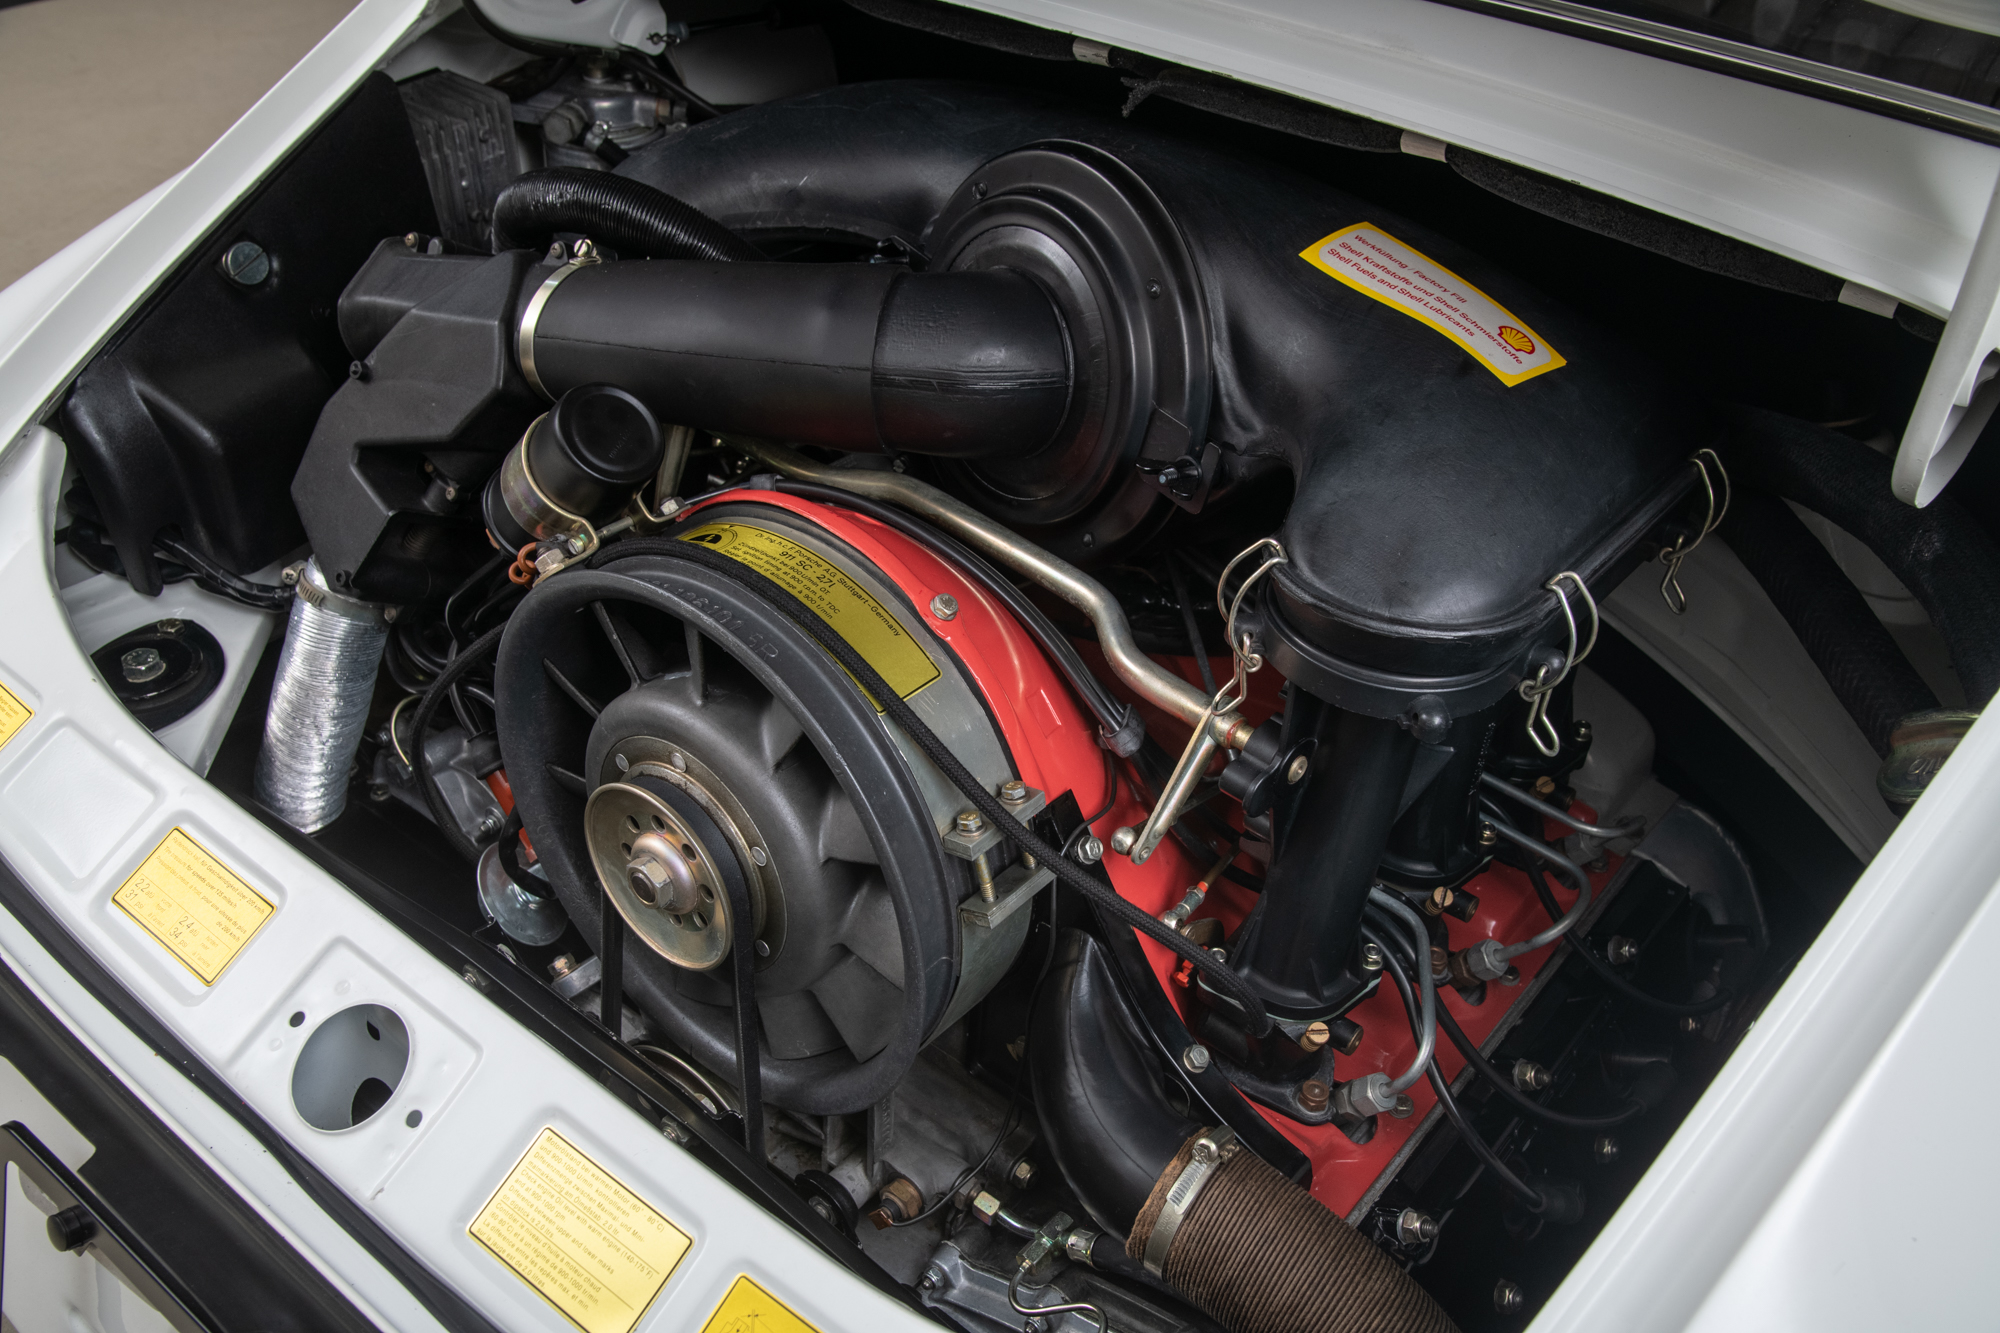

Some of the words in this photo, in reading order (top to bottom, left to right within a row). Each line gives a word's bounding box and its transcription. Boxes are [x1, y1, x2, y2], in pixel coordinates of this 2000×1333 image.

[1354, 234, 1408, 269] Werkfüllung
[1413, 270, 1450, 293] Factory
[1450, 289, 1468, 304] Fill
[1327, 248, 1351, 264] Shell
[1351, 262, 1378, 280] Fuels
[1377, 278, 1398, 290] and
[1397, 287, 1424, 304] Shell
[1423, 301, 1476, 337] Lubricants
[1338, 241, 1363, 258] Shell
[1363, 255, 1413, 287] Kraftstoffe
[1413, 284, 1435, 298] und
[1434, 294, 1459, 314] Shell
[1459, 312, 1523, 366] Schmierstoffe
[779, 550, 796, 561] 911
[796, 560, 813, 571] SC
[794, 547, 823, 568] Porsche
[764, 560, 782, 572] timing
[790, 574, 803, 585] 900
[826, 602, 841, 615] TDC
[803, 594, 817, 605] 900
[124, 888, 138, 901] 31
[133, 877, 151, 894] 2,2
[185, 864, 193, 872] for
[191, 869, 207, 884] speeds
[205, 881, 216, 891] over
[168, 926, 182, 940] 34
[177, 914, 194, 932] 2,4
[539, 1144, 551, 1155] und
[550, 1152, 577, 1175] 900-1000
[594, 1187, 630, 1218] kontrollieren
[545, 1135, 582, 1166] Motorölstand
[580, 1163, 591, 1173] bei
[590, 1172, 612, 1191] warmen
[612, 1188, 630, 1204] Motor
[509, 1199, 531, 1219] dipstick
[514, 1177, 525, 1188] and
[530, 1190, 555, 1212] 900-1000
[553, 1210, 567, 1223] rpm.
[520, 1168, 537, 1184] Check
[535, 1182, 555, 1200] engine
[554, 1196, 564, 1205] Oil
[562, 1203, 577, 1216] level
[575, 1213, 588, 1225] with
[587, 1224, 602, 1237] warm
[601, 1235, 621, 1254] engine
[532, 1151, 573, 1186] Differenzmenge
[572, 1182, 597, 1204] zwischen
[619, 1220, 631, 1232] und
[564, 1190, 573, 1199] am
[475, 1227, 486, 1237] sur
[489, 1239, 507, 1255] jauge
[505, 1251, 516, 1261] est
[514, 1259, 523, 1268] de
[507, 1184, 535, 1208] Difference
[533, 1205, 557, 1226] between
[554, 1224, 572, 1240] upper
[571, 1236, 583, 1248] and
[581, 1245, 598, 1260] lower
[596, 1258, 615, 1275] marks
[514, 1245, 530, 1260] entre
[528, 1257, 539, 1267] les
[524, 1226, 543, 1243] niveau
[541, 1240, 561, 1258] d'huile
[564, 1260, 584, 1278] moteur
[582, 1275, 602, 1293] chaud
[530, 1245, 551, 1264] régime
[549, 1261, 558, 1270] de
[556, 1267, 584, 1291] 900-1000
